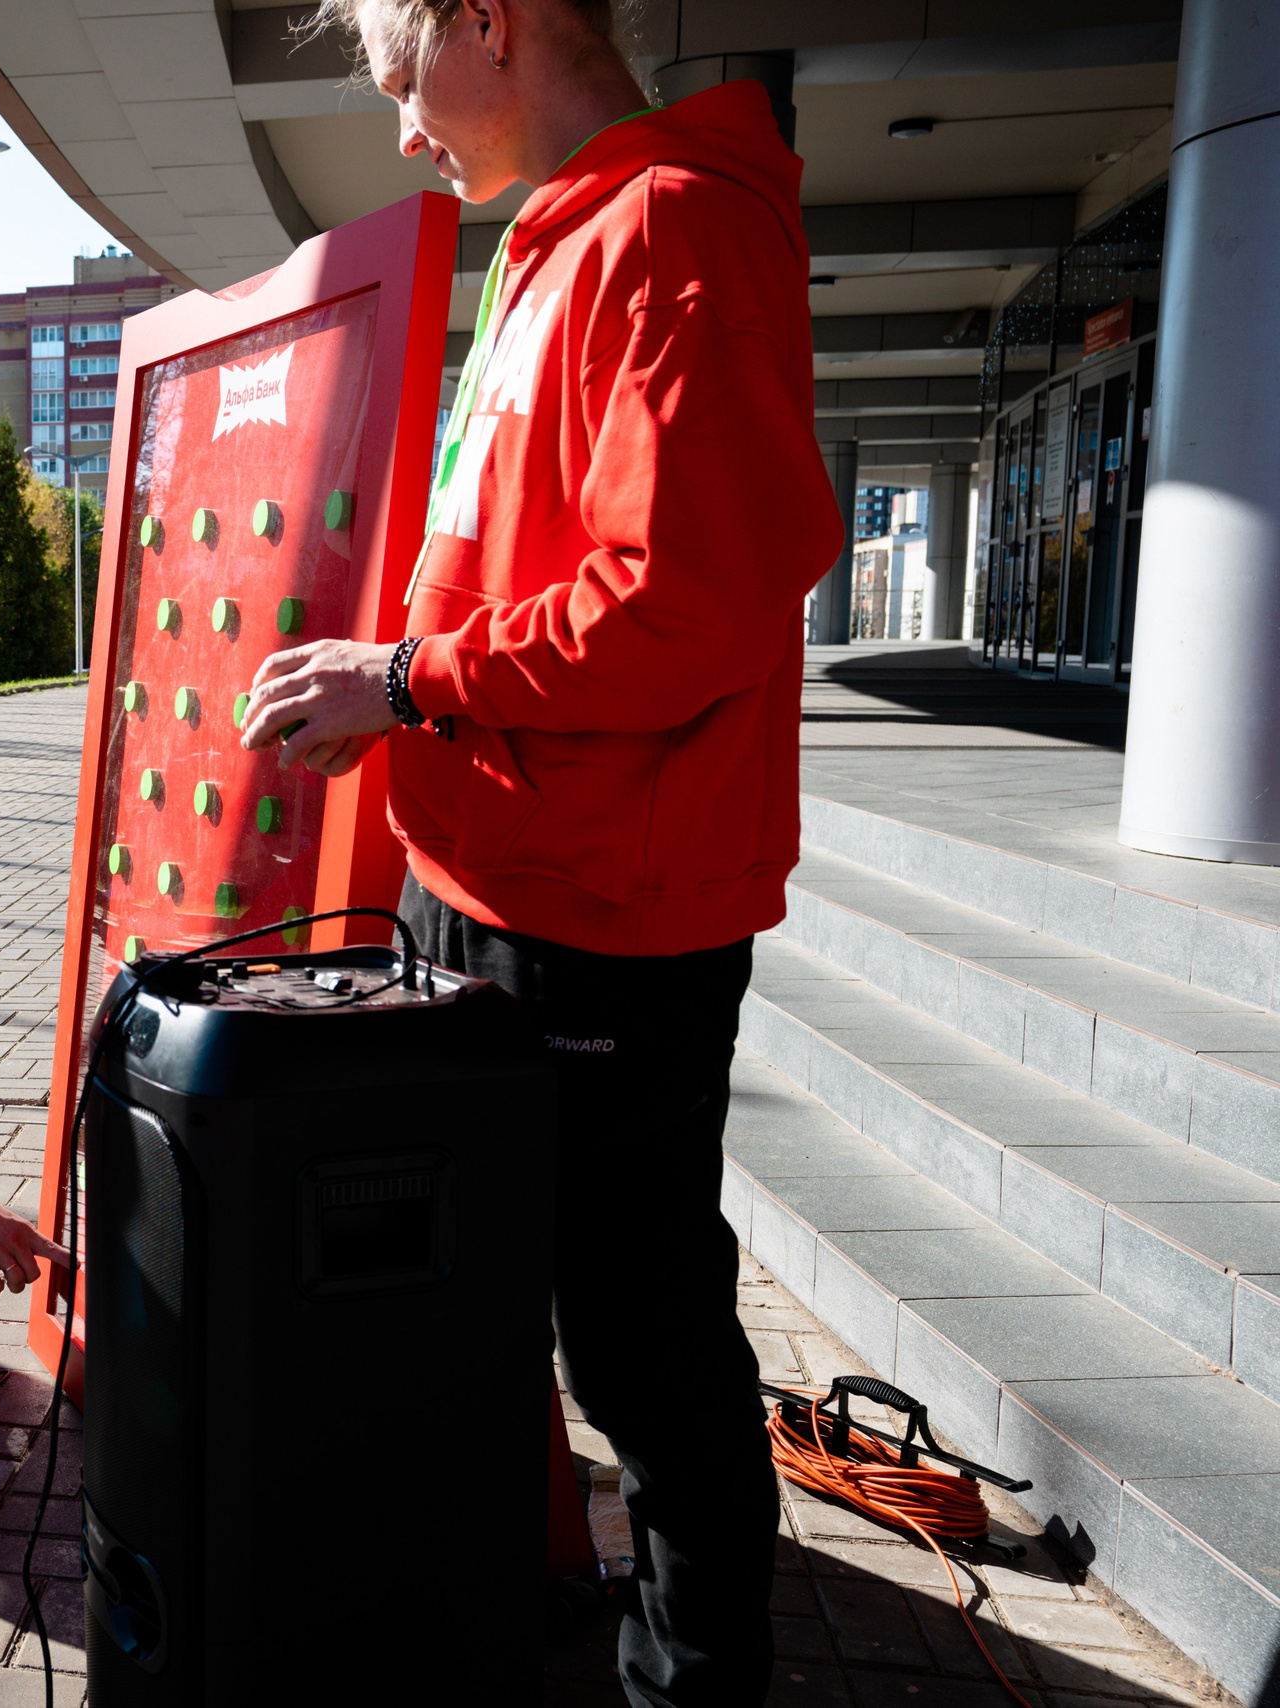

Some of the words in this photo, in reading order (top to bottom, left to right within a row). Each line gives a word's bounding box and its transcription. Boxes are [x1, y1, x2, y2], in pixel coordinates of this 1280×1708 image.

[224, 384, 255, 408] Альфа
[256, 379, 281, 400] Банк
[544, 1035, 615, 1052] ORWARD
